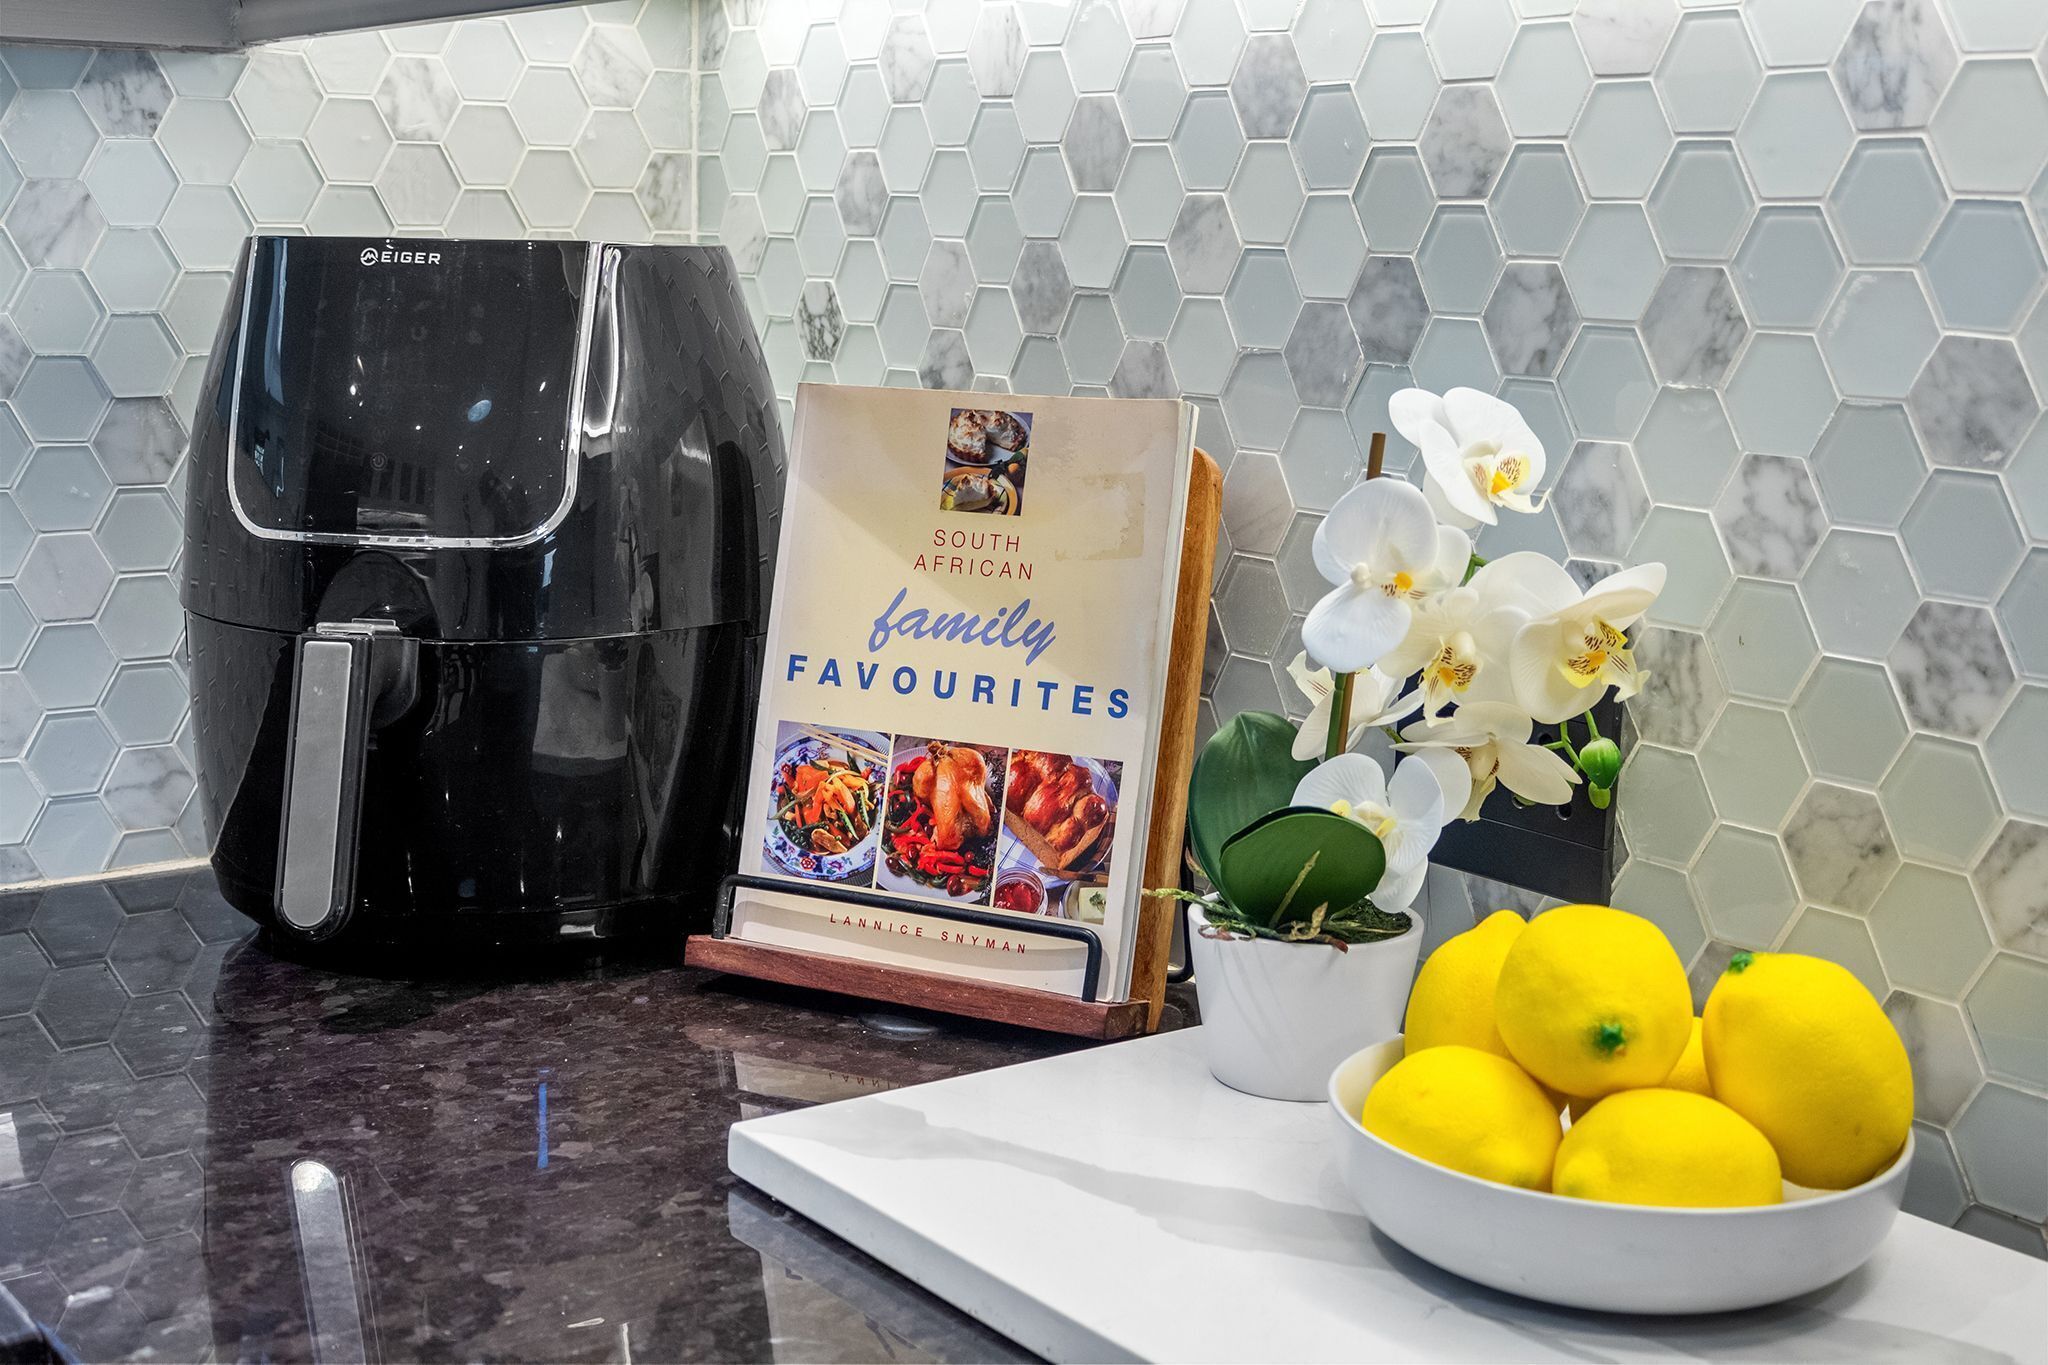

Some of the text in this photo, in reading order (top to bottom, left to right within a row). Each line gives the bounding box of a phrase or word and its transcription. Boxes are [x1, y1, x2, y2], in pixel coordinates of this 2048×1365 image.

[381, 251, 441, 265] EIGER
[933, 529, 1020, 553] SOUTH
[914, 554, 1033, 581] AFRICAN
[868, 587, 1056, 666] family
[787, 654, 1130, 719] FAVOURITES
[830, 913, 1026, 954] LANNICE SNYMAN
